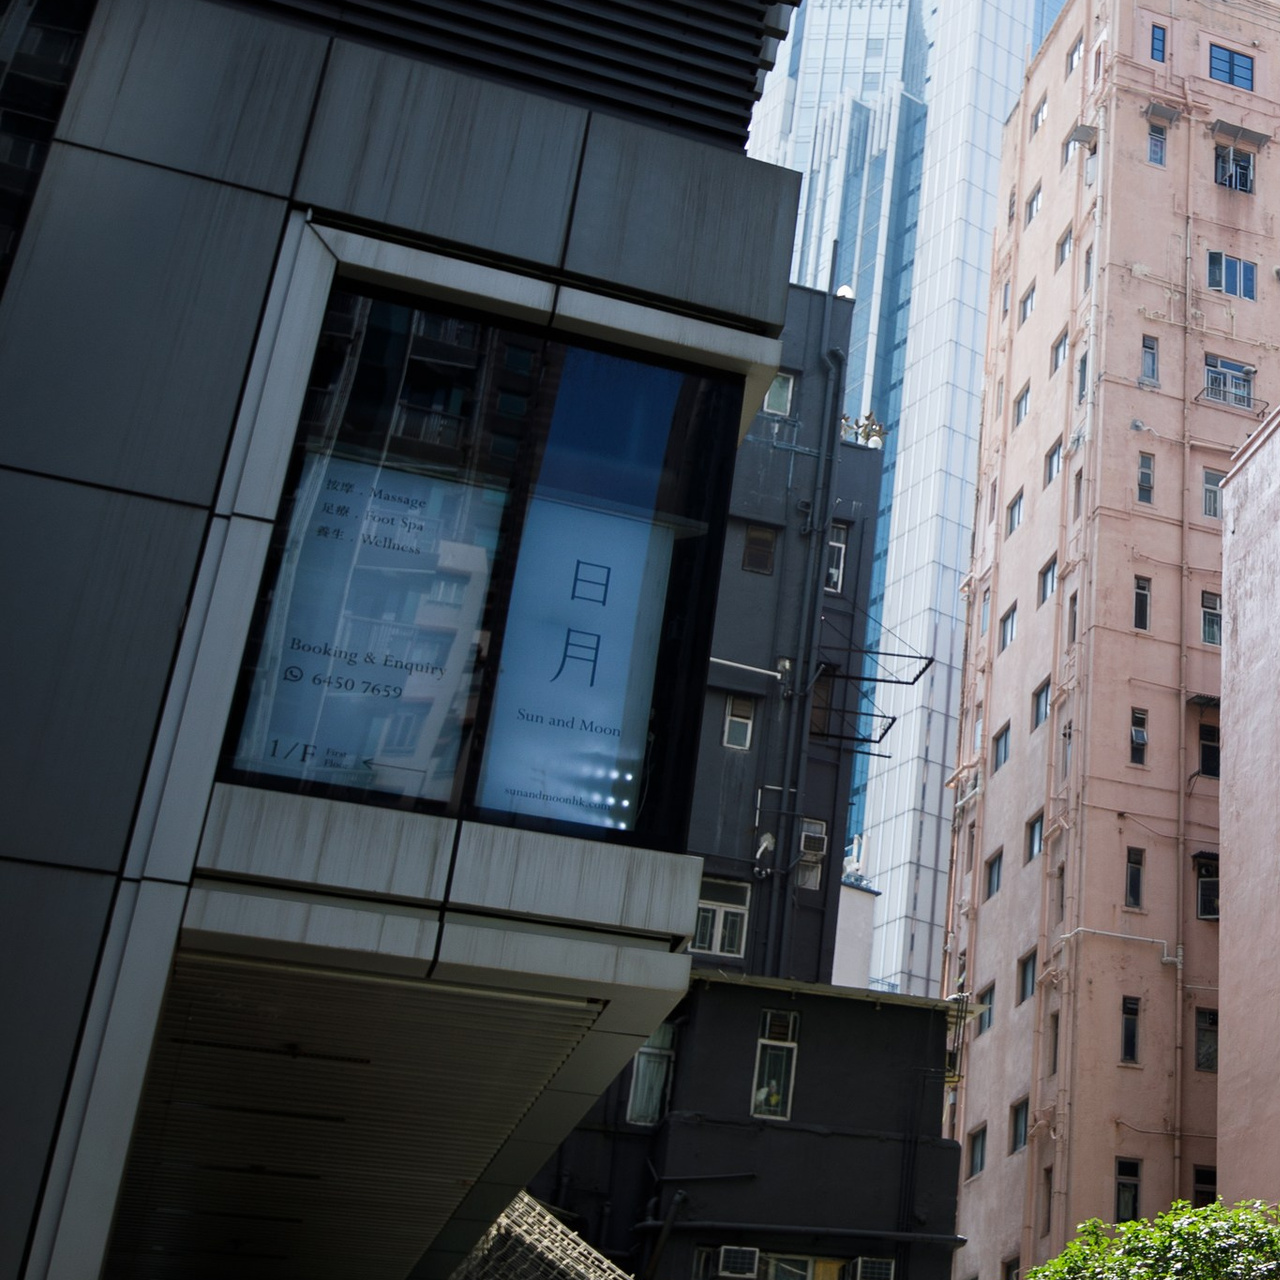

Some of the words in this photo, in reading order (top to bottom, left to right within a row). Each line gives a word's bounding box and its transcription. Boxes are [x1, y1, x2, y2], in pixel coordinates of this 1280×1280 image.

[369, 487, 427, 510] Massage
[365, 510, 396, 525] Foot
[401, 517, 424, 533] Spa
[361, 533, 421, 555] Wellness
[290, 637, 358, 666] Booking
[364, 651, 376, 664] &
[383, 654, 447, 680] Enquiry
[312, 673, 355, 691] 6450
[361, 680, 403, 699] 7659
[517, 708, 543, 725] Sun
[549, 716, 575, 730] and
[580, 719, 621, 738] Moon
[504, 786, 611, 811] sunandmoonhk.com
